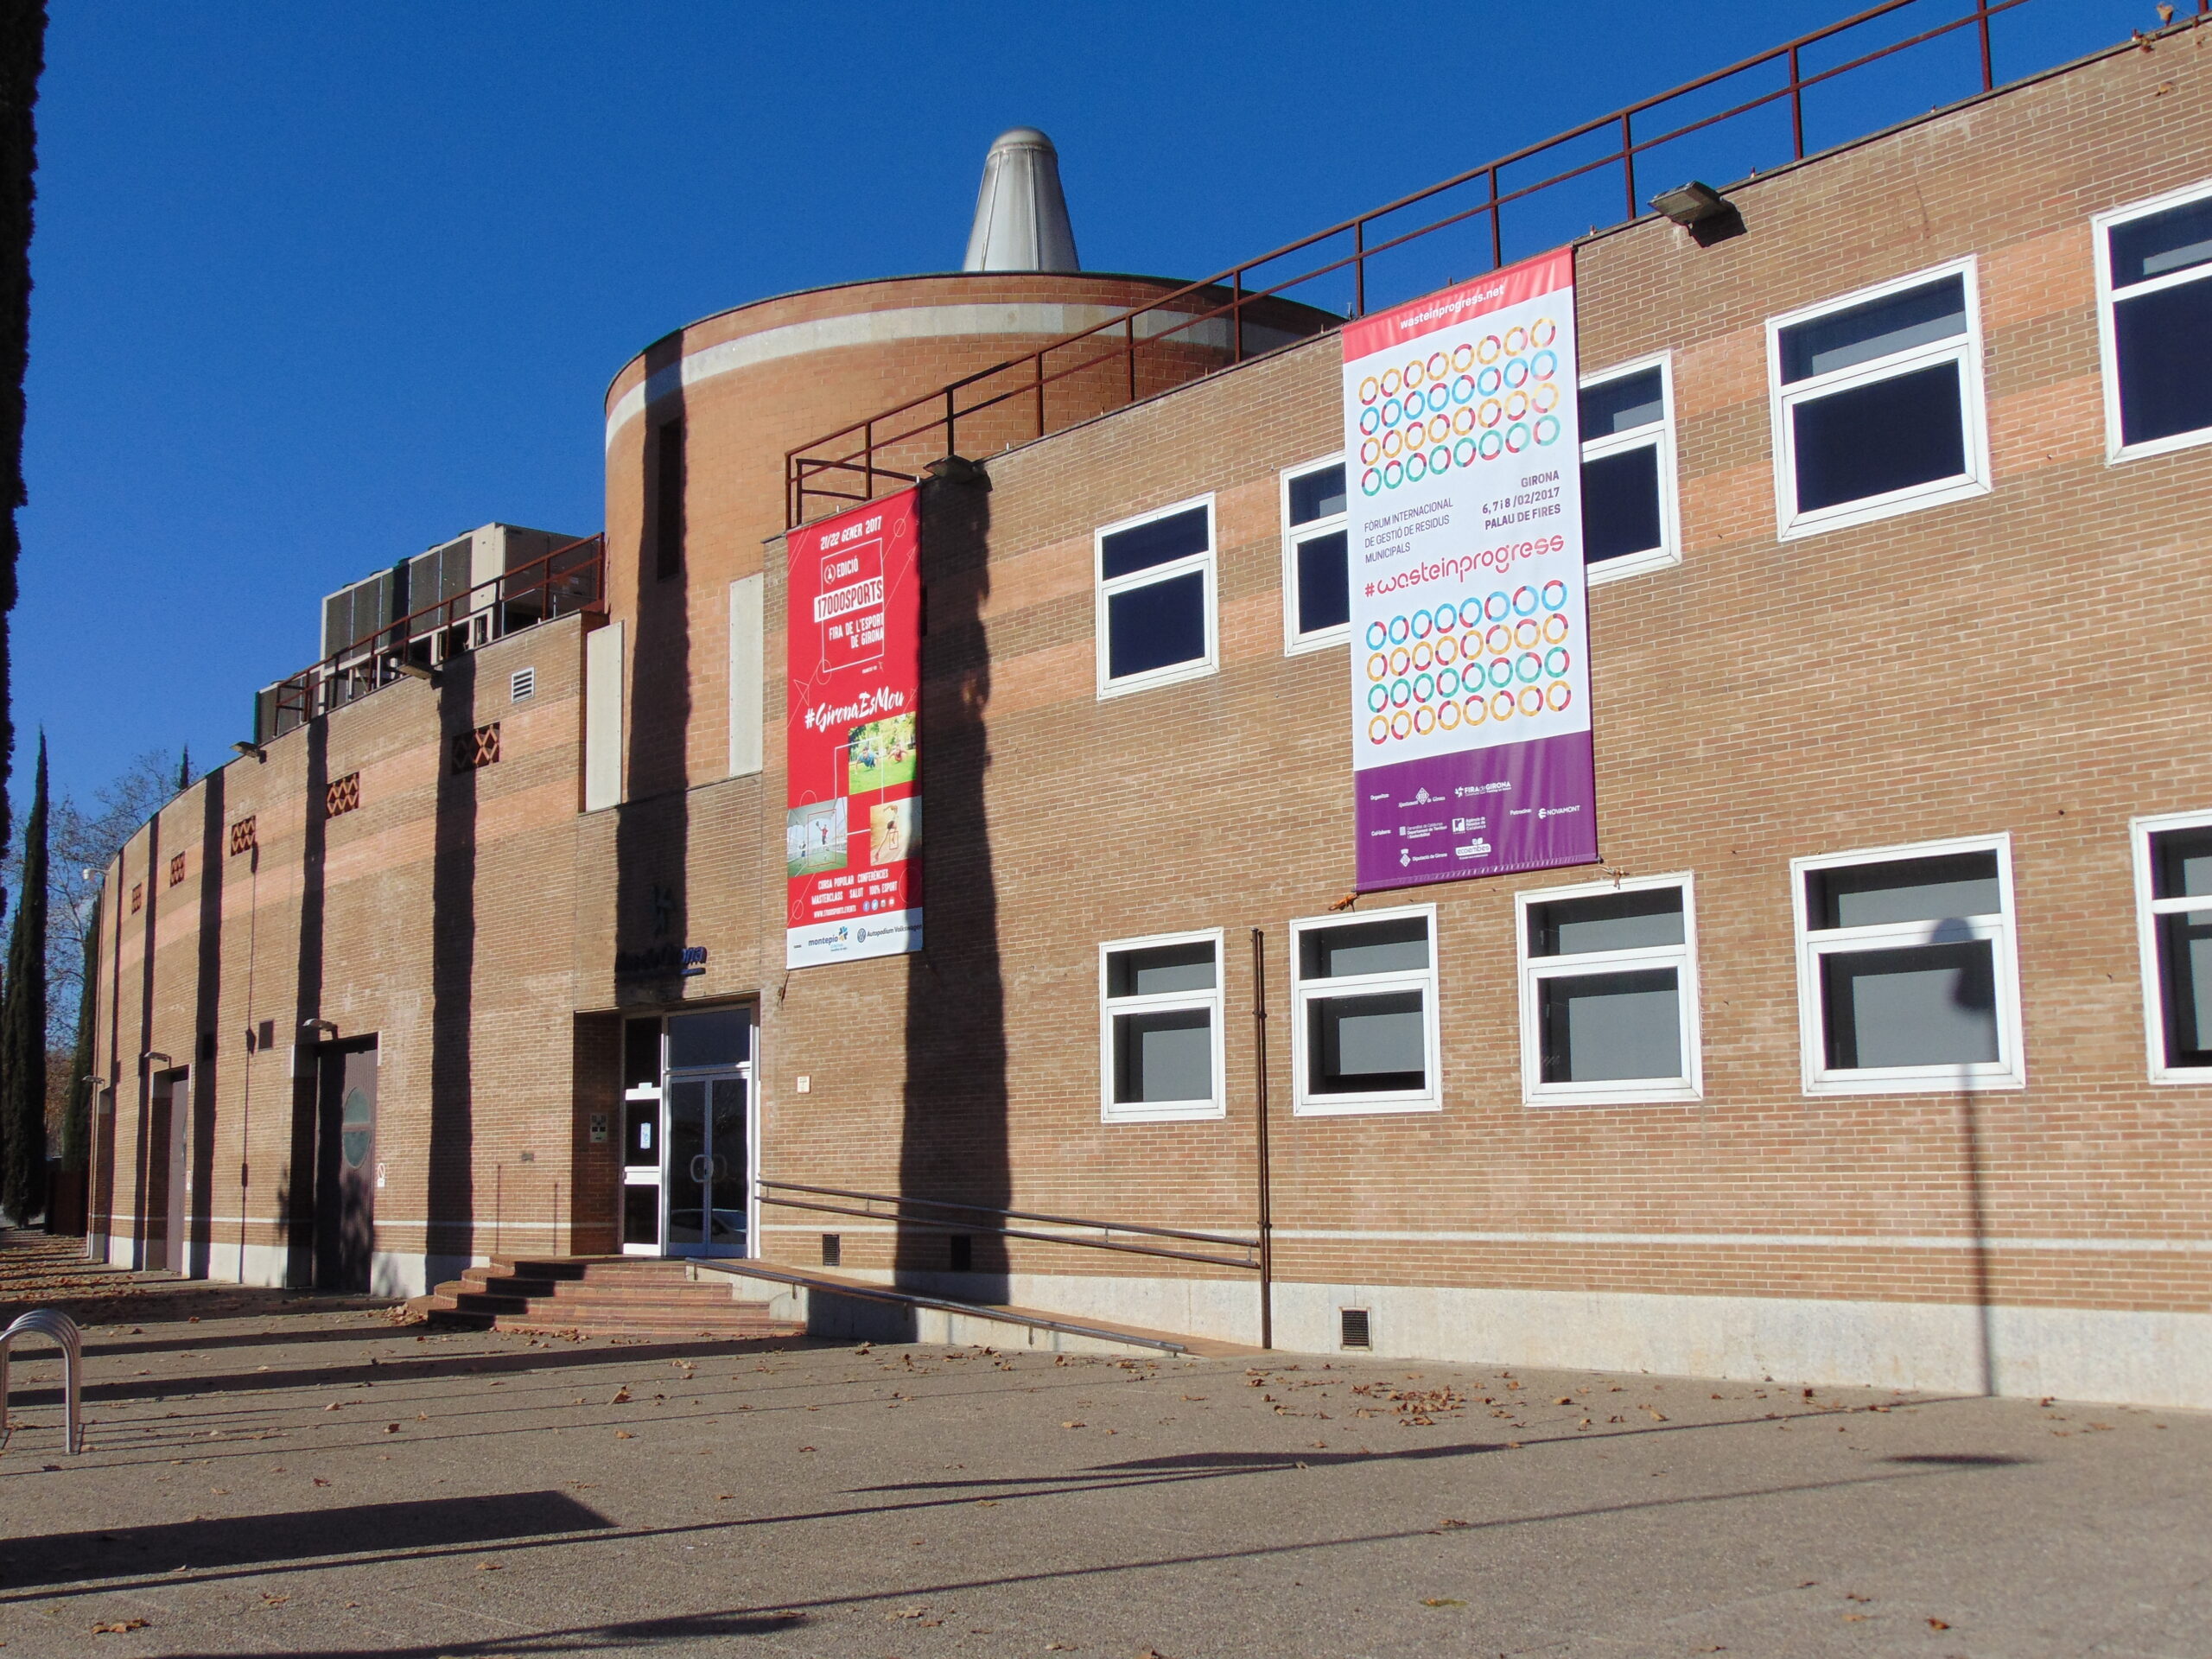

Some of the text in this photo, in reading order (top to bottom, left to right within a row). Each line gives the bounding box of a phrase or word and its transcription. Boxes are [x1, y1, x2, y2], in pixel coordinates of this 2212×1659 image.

[1400, 284, 1505, 330] wasteinprogress.net
[1521, 470, 1560, 487] GIRONA
[1392, 497, 1453, 524] INTERNACIONAL
[1482, 486, 1560, 515] 6, 7 i 8 /02/2017
[1484, 504, 1560, 531] PALAU DE FIRES
[820, 515, 882, 551] 21/22 GENER 2017
[1364, 514, 1450, 549] DE GESTIÓ DE RESIDUS
[1364, 534, 1564, 598] #wasteinprogress
[1365, 542, 1410, 564] MUNICIPALS
[836, 555, 859, 578] EDICIÓ
[829, 613, 883, 641] FIRA DE L'ESPORT
[850, 627, 883, 649] DE GIRONA
[804, 685, 905, 733] #GironaEsMou
[1547, 804, 1580, 816] NOVAMONT
[1457, 844, 1490, 855] ecoembes
[817, 868, 888, 891] CURSA POPULAR CONFERÈNCIES
[811, 880, 898, 906] MASTERCLASS SALUT 100% ESPORT
[867, 924, 922, 938] Autopodium Volkswagen
